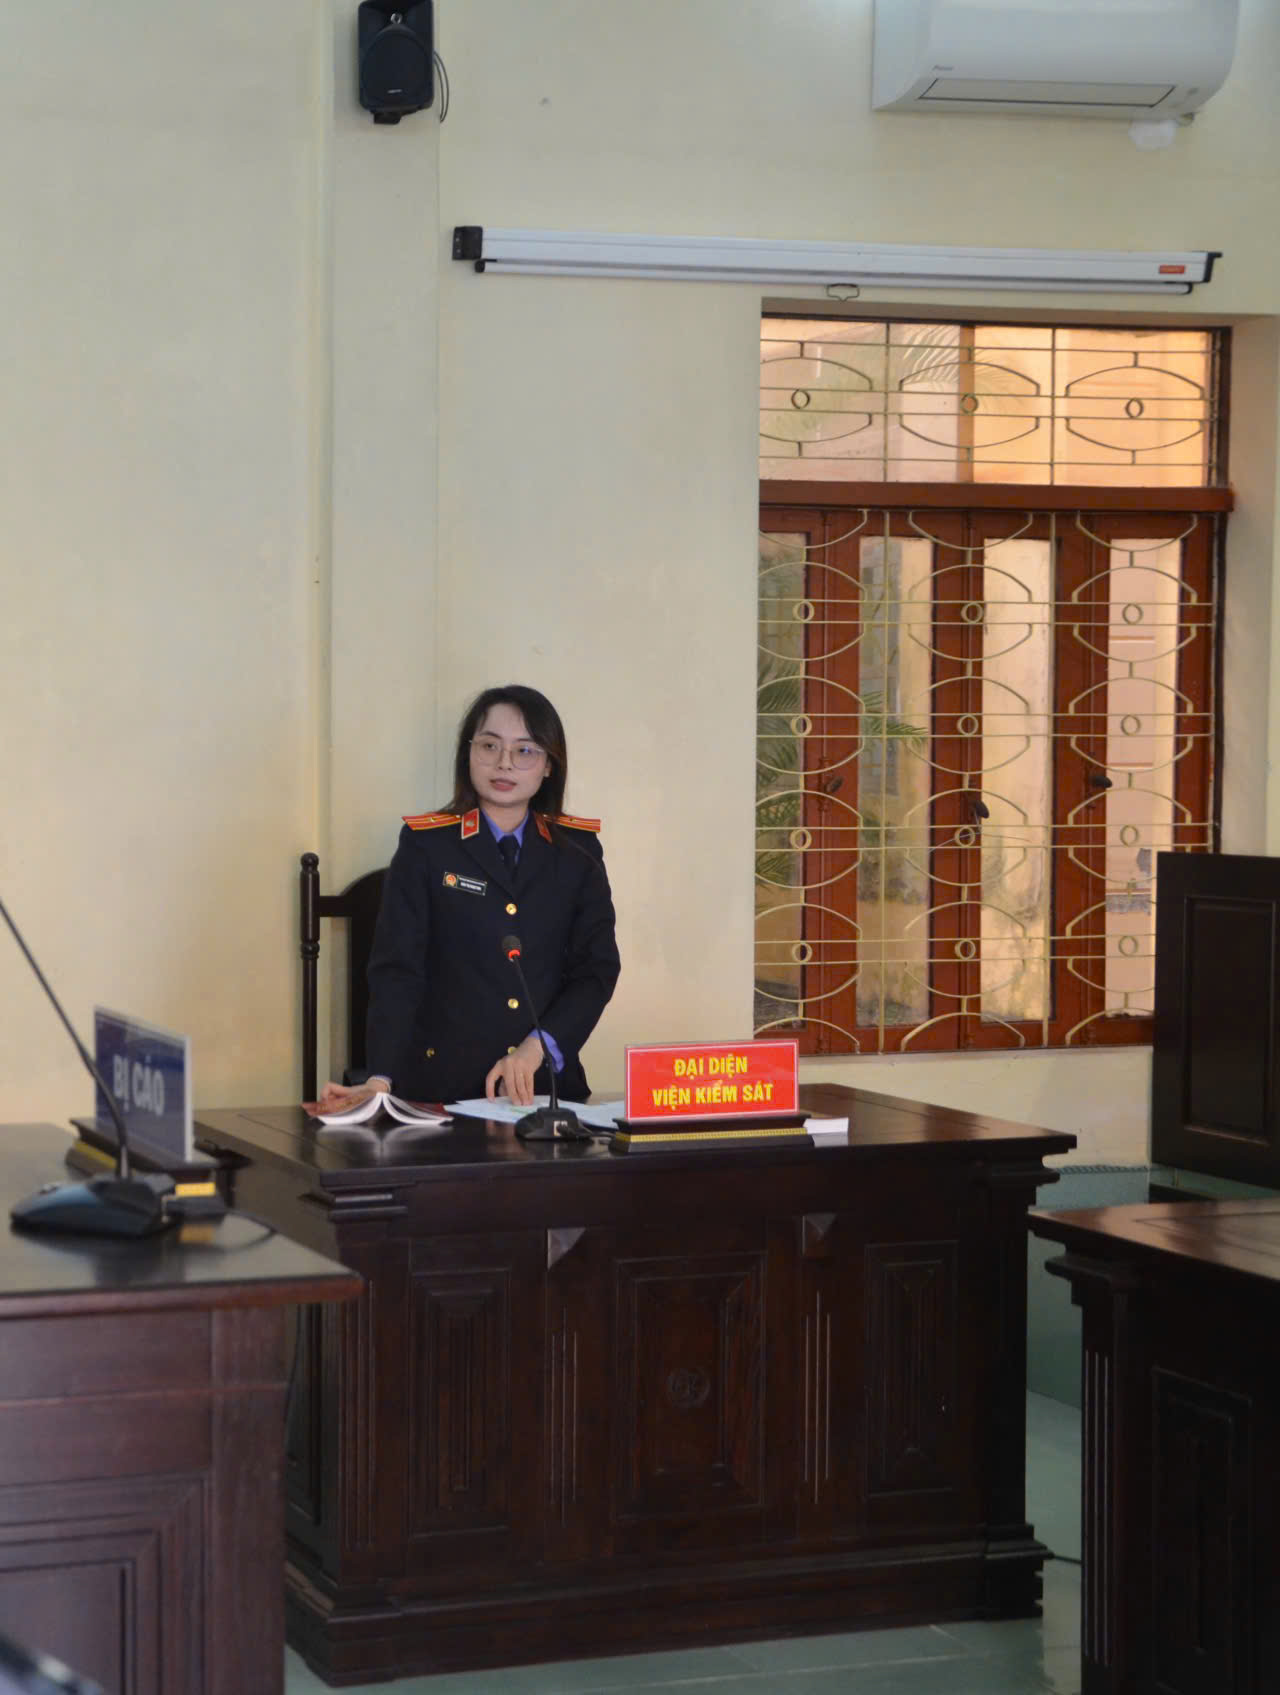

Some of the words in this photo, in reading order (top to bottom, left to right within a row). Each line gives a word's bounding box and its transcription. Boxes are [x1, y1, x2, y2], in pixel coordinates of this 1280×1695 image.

[673, 1058, 704, 1080] ĐẠI
[709, 1053, 748, 1078] DIỆN
[113, 1054, 129, 1112] BỊ
[132, 1055, 165, 1116] CÁO
[652, 1084, 691, 1110] VIỆN
[742, 1080, 774, 1102] SÁT
